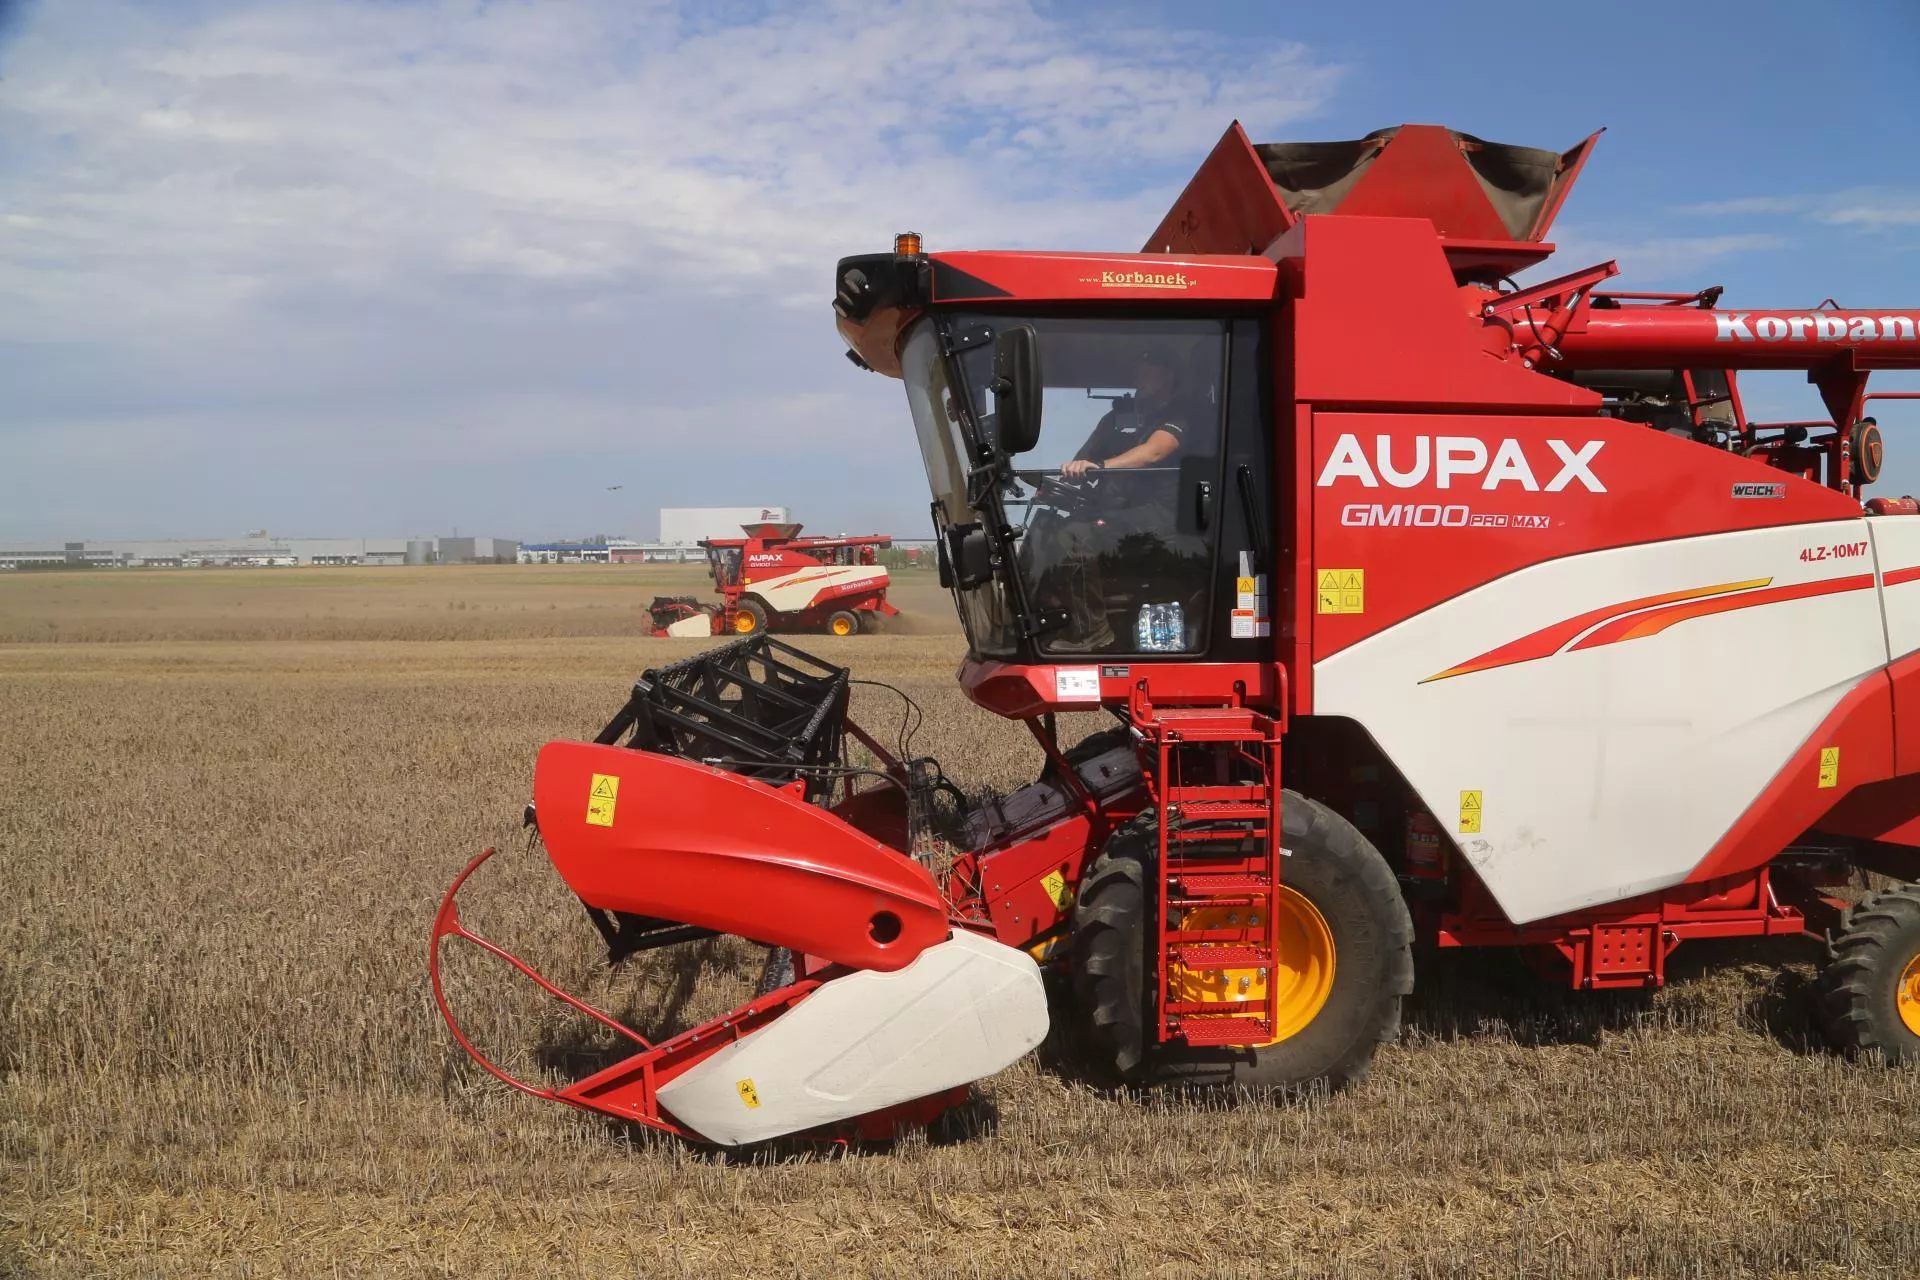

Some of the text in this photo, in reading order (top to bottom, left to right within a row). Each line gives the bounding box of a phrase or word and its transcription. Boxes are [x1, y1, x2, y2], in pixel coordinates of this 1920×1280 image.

[1079, 271, 1197, 287] www.Korbanek.pl
[1712, 312, 1920, 342] Korban
[1316, 433, 1608, 493] AUPAX
[1341, 504, 1551, 529] GM100 PRO MAX
[748, 554, 783, 562] AUPAX
[1799, 541, 1868, 563] 4LZ-10M7
